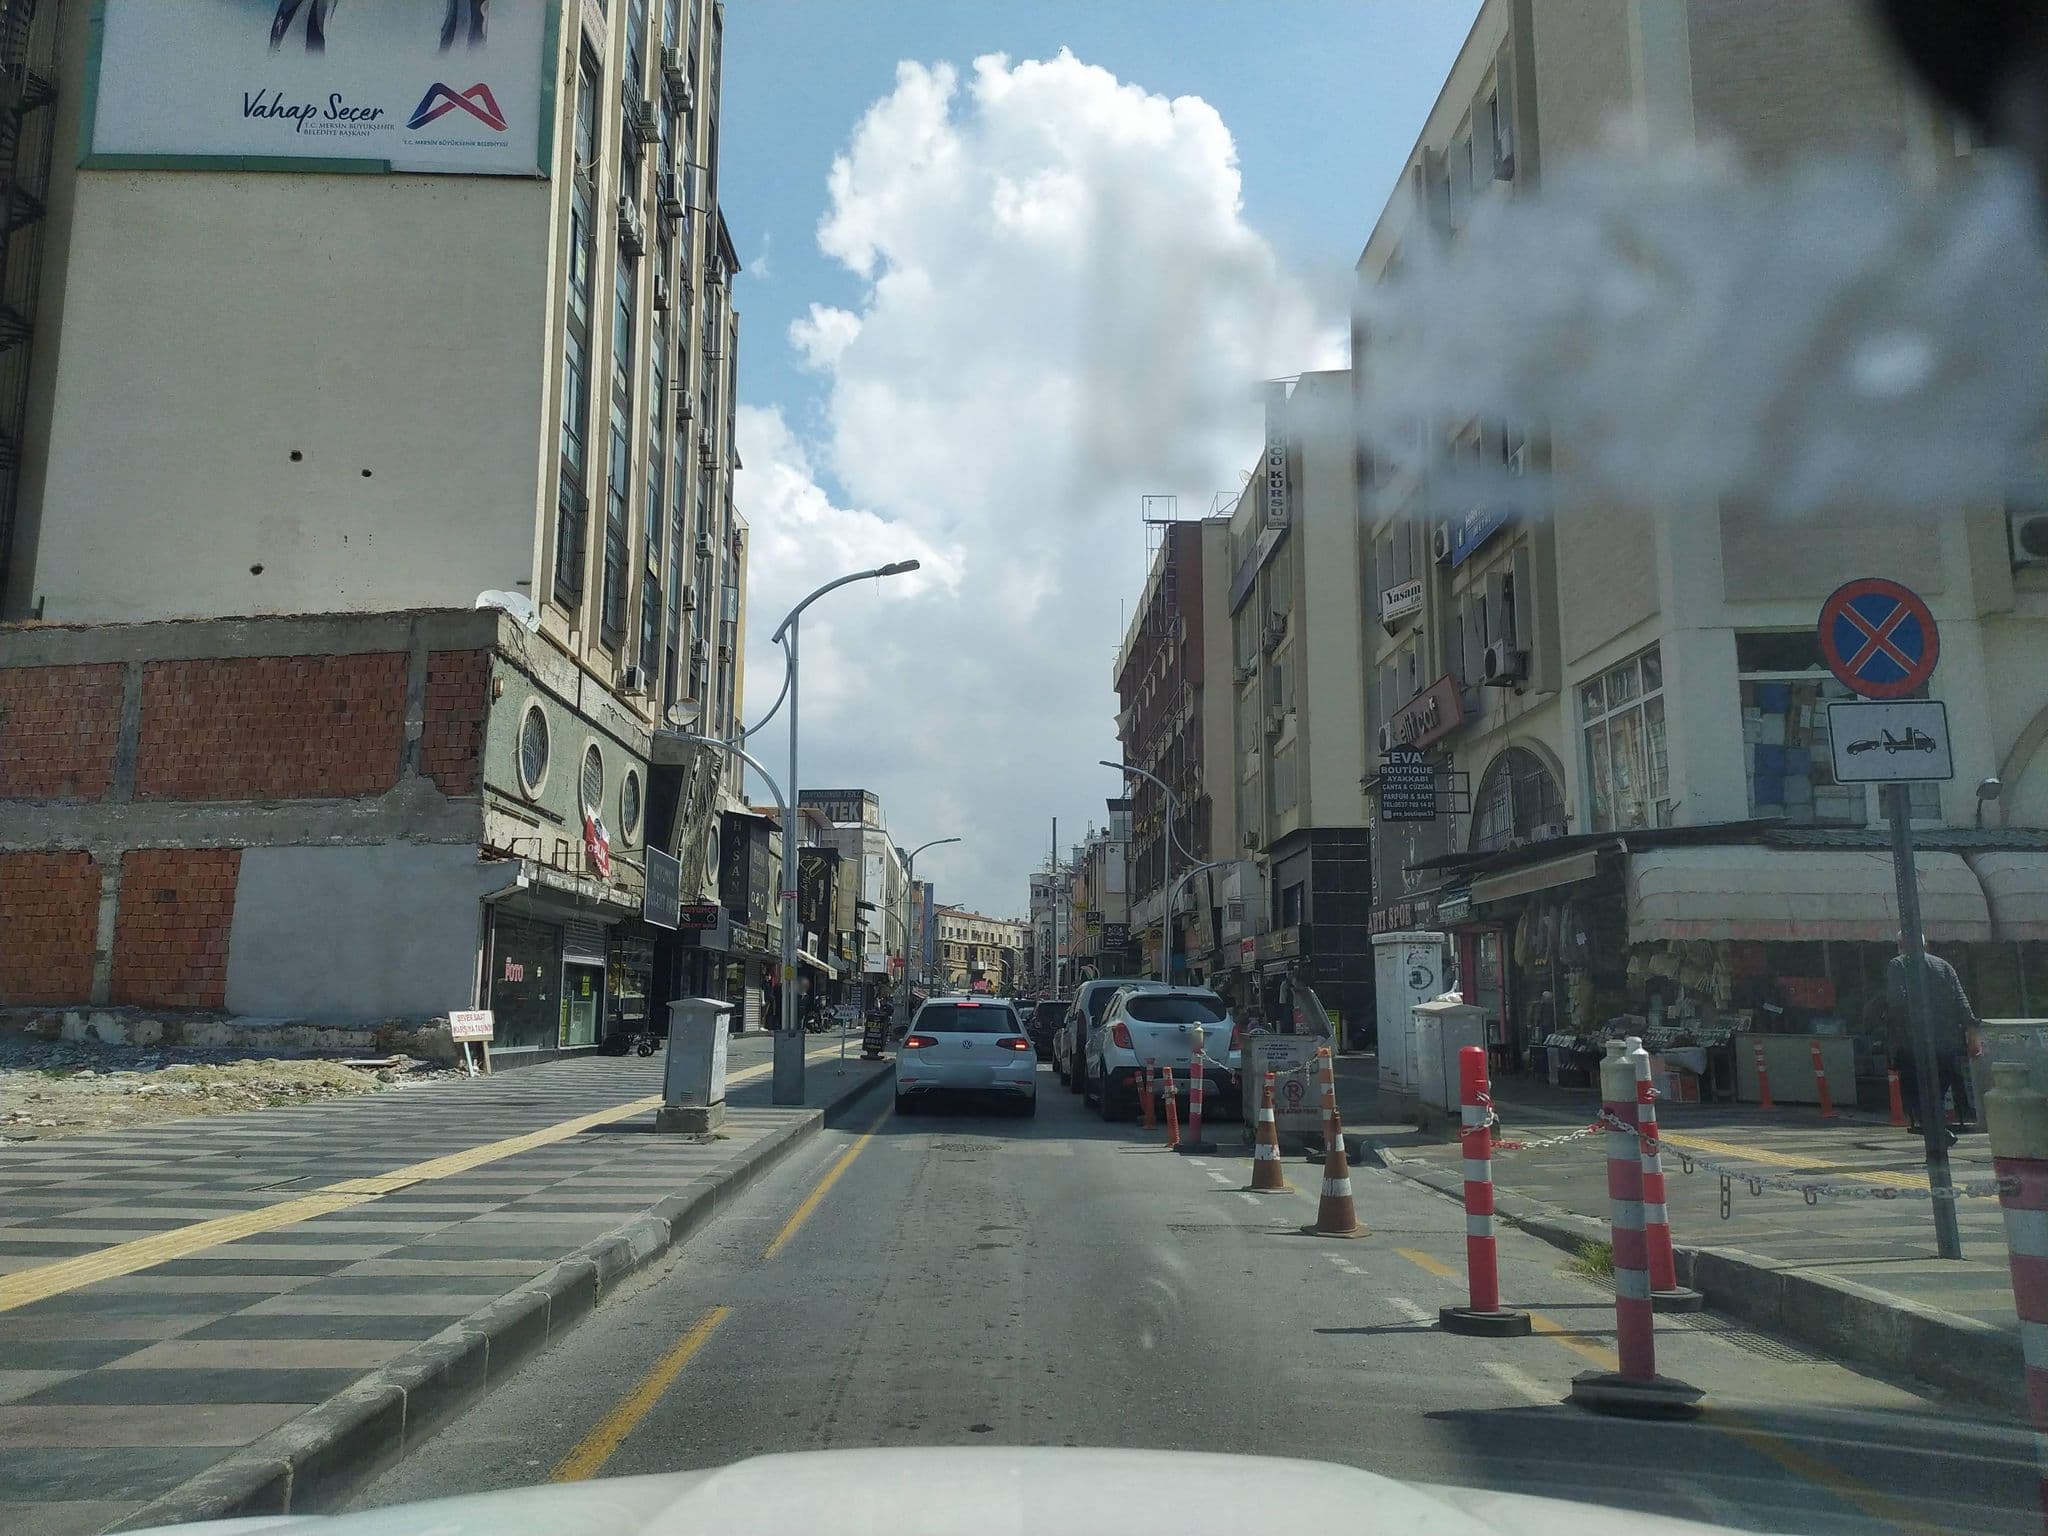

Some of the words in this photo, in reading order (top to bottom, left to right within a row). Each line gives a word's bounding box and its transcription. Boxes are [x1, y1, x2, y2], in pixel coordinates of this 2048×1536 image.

[243, 88, 317, 133] Vahap
[324, 93, 384, 123] Seçer
[1270, 471, 1283, 516] KURSU
[1381, 765, 1433, 774] BOUTİQUE
[1391, 752, 1423, 764] EVA
